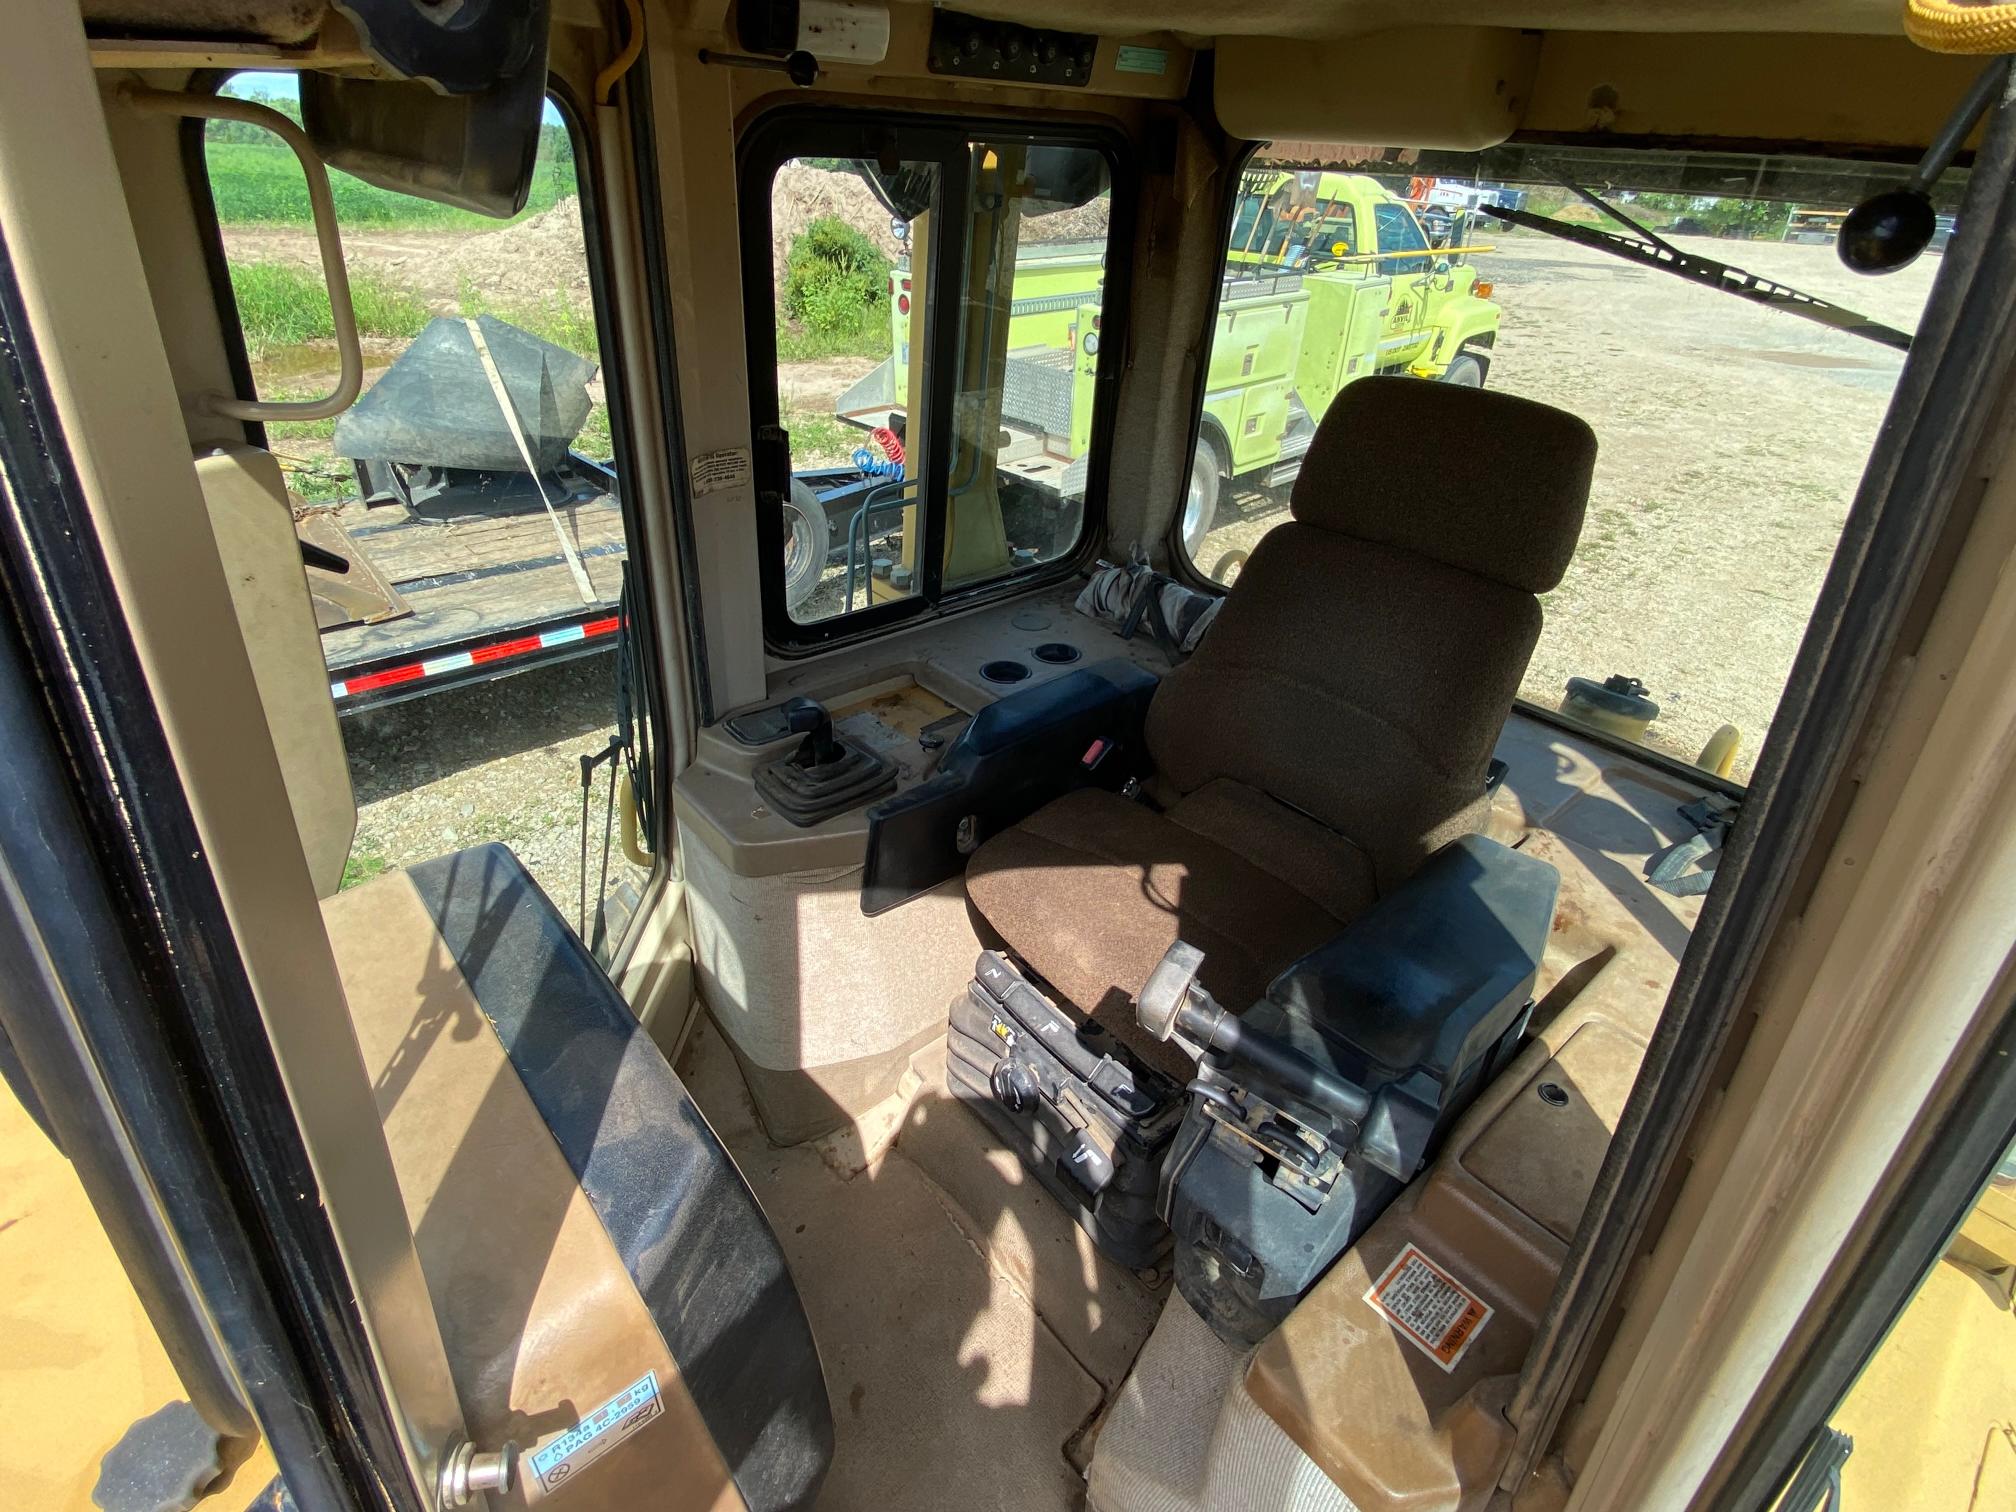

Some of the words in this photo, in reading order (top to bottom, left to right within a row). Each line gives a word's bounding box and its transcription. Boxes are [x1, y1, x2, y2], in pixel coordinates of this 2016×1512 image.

[1441, 1317, 1472, 1354] WARNING
[552, 1424, 590, 1453] R134a
[634, 1383, 649, 1397] kg
[566, 1431, 593, 1453] PAG
